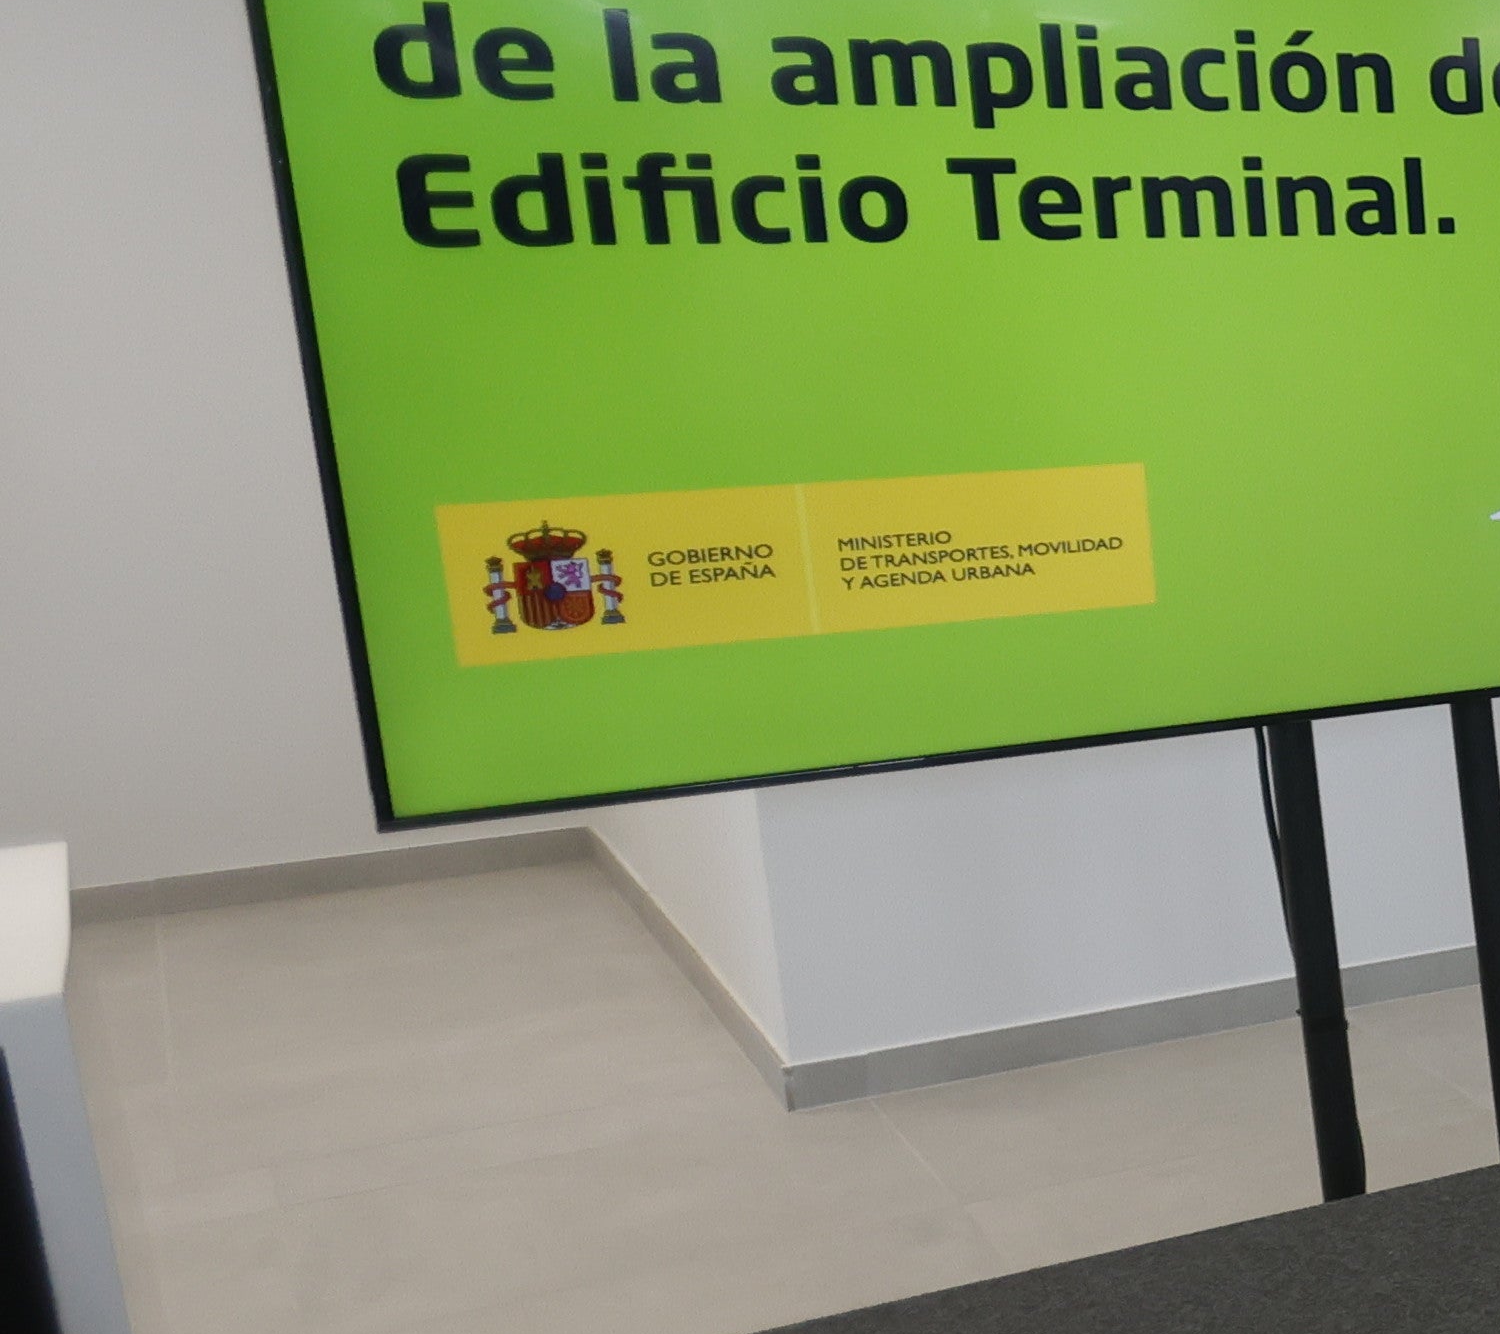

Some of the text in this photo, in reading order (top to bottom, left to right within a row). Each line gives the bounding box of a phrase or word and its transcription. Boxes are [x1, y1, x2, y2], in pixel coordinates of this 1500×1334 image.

[373, 0, 556, 101] de
[605, 8, 722, 104] la
[770, 23, 1396, 130] ampliación
[395, 152, 1457, 249] Edificio Terminal.
[647, 543, 774, 568] GOBIERNO
[837, 529, 952, 552] MINISTERIO
[839, 535, 1123, 572] DE TRANSPORTES, MOVILIDAD
[649, 559, 777, 588] DE ESPAÑA
[841, 561, 1036, 591] Y AGENDA URBANA
